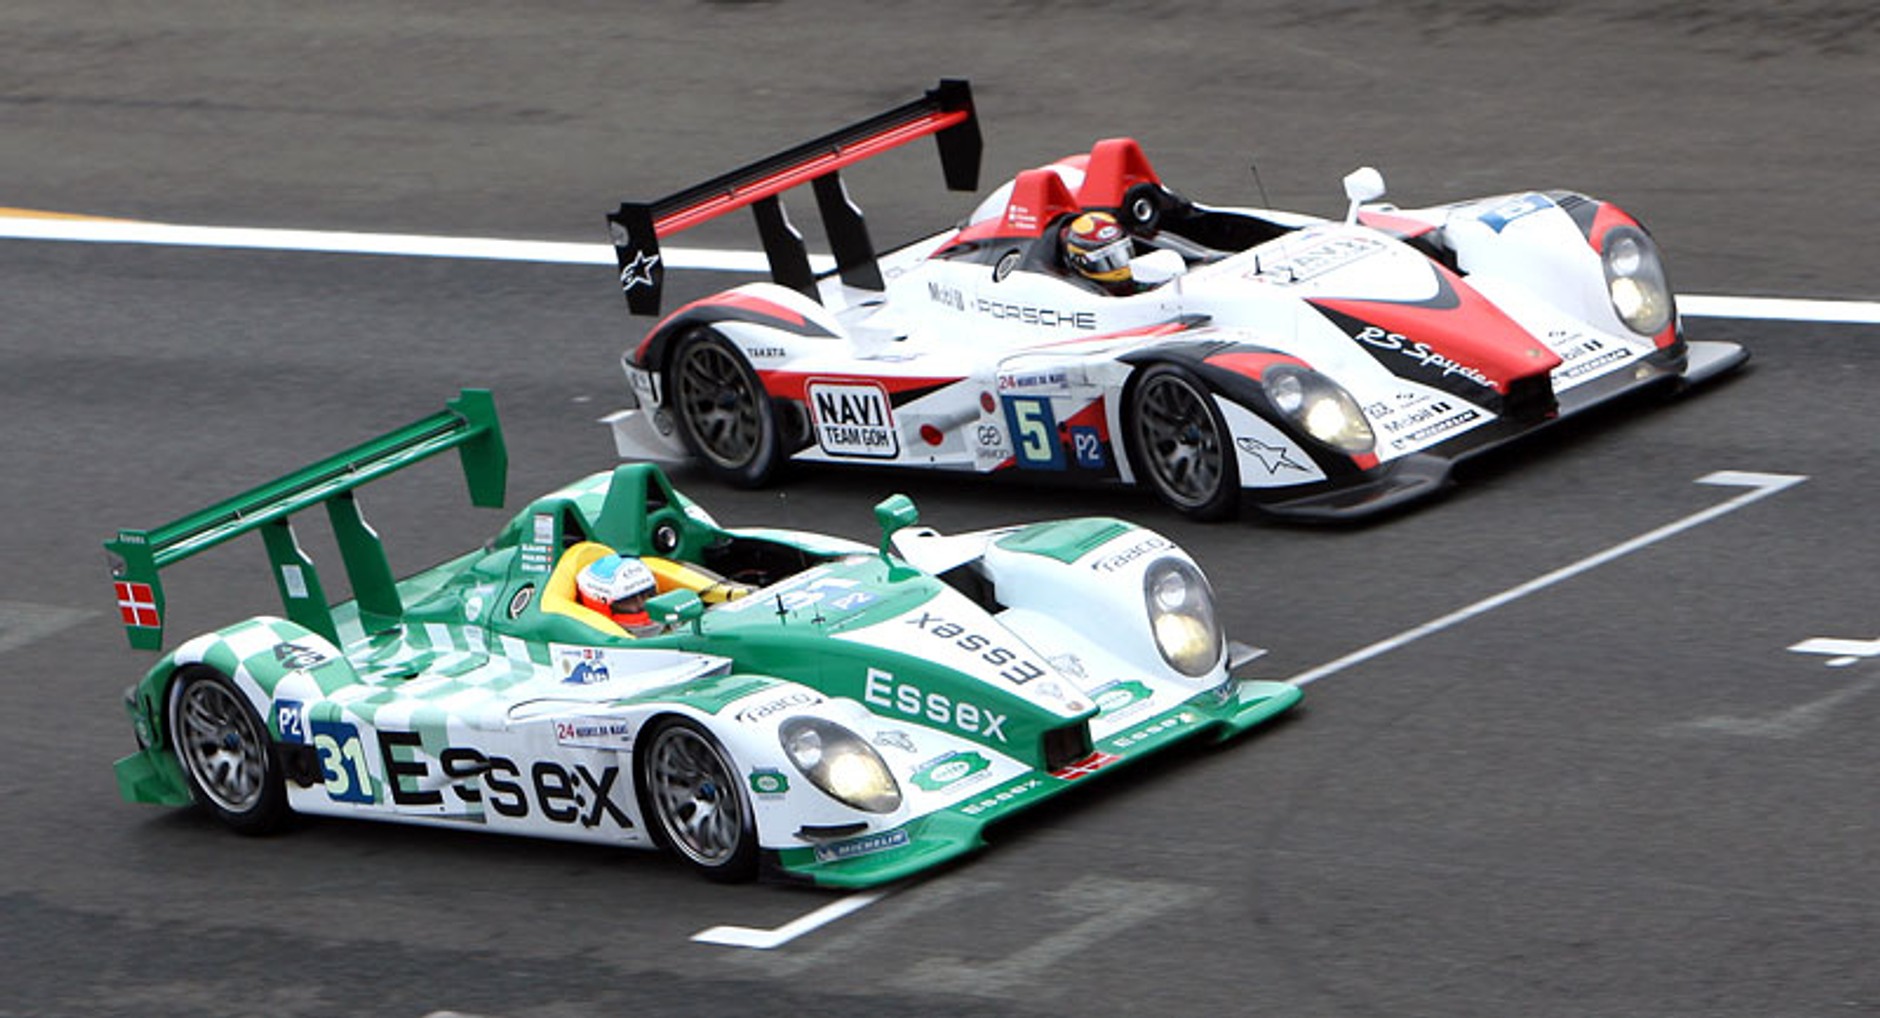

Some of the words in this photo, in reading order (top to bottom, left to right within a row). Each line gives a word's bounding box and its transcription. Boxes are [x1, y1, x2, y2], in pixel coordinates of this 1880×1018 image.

[977, 299, 1096, 330] PORSCHE
[1355, 326, 1407, 350] RS
[1402, 342, 1499, 387] Spyder
[998, 375, 1016, 389] 24
[815, 392, 885, 427] NAVI
[824, 426, 861, 444] TEAM
[862, 430, 889, 447] GOH
[1013, 400, 1052, 461] 5
[1074, 434, 1099, 460] P2
[864, 666, 1008, 742] Essex
[279, 707, 302, 736] P2
[557, 723, 575, 739] 24
[314, 734, 373, 796] 31
[376, 729, 634, 829] Essex
[838, 834, 903, 853] MICHELIN
